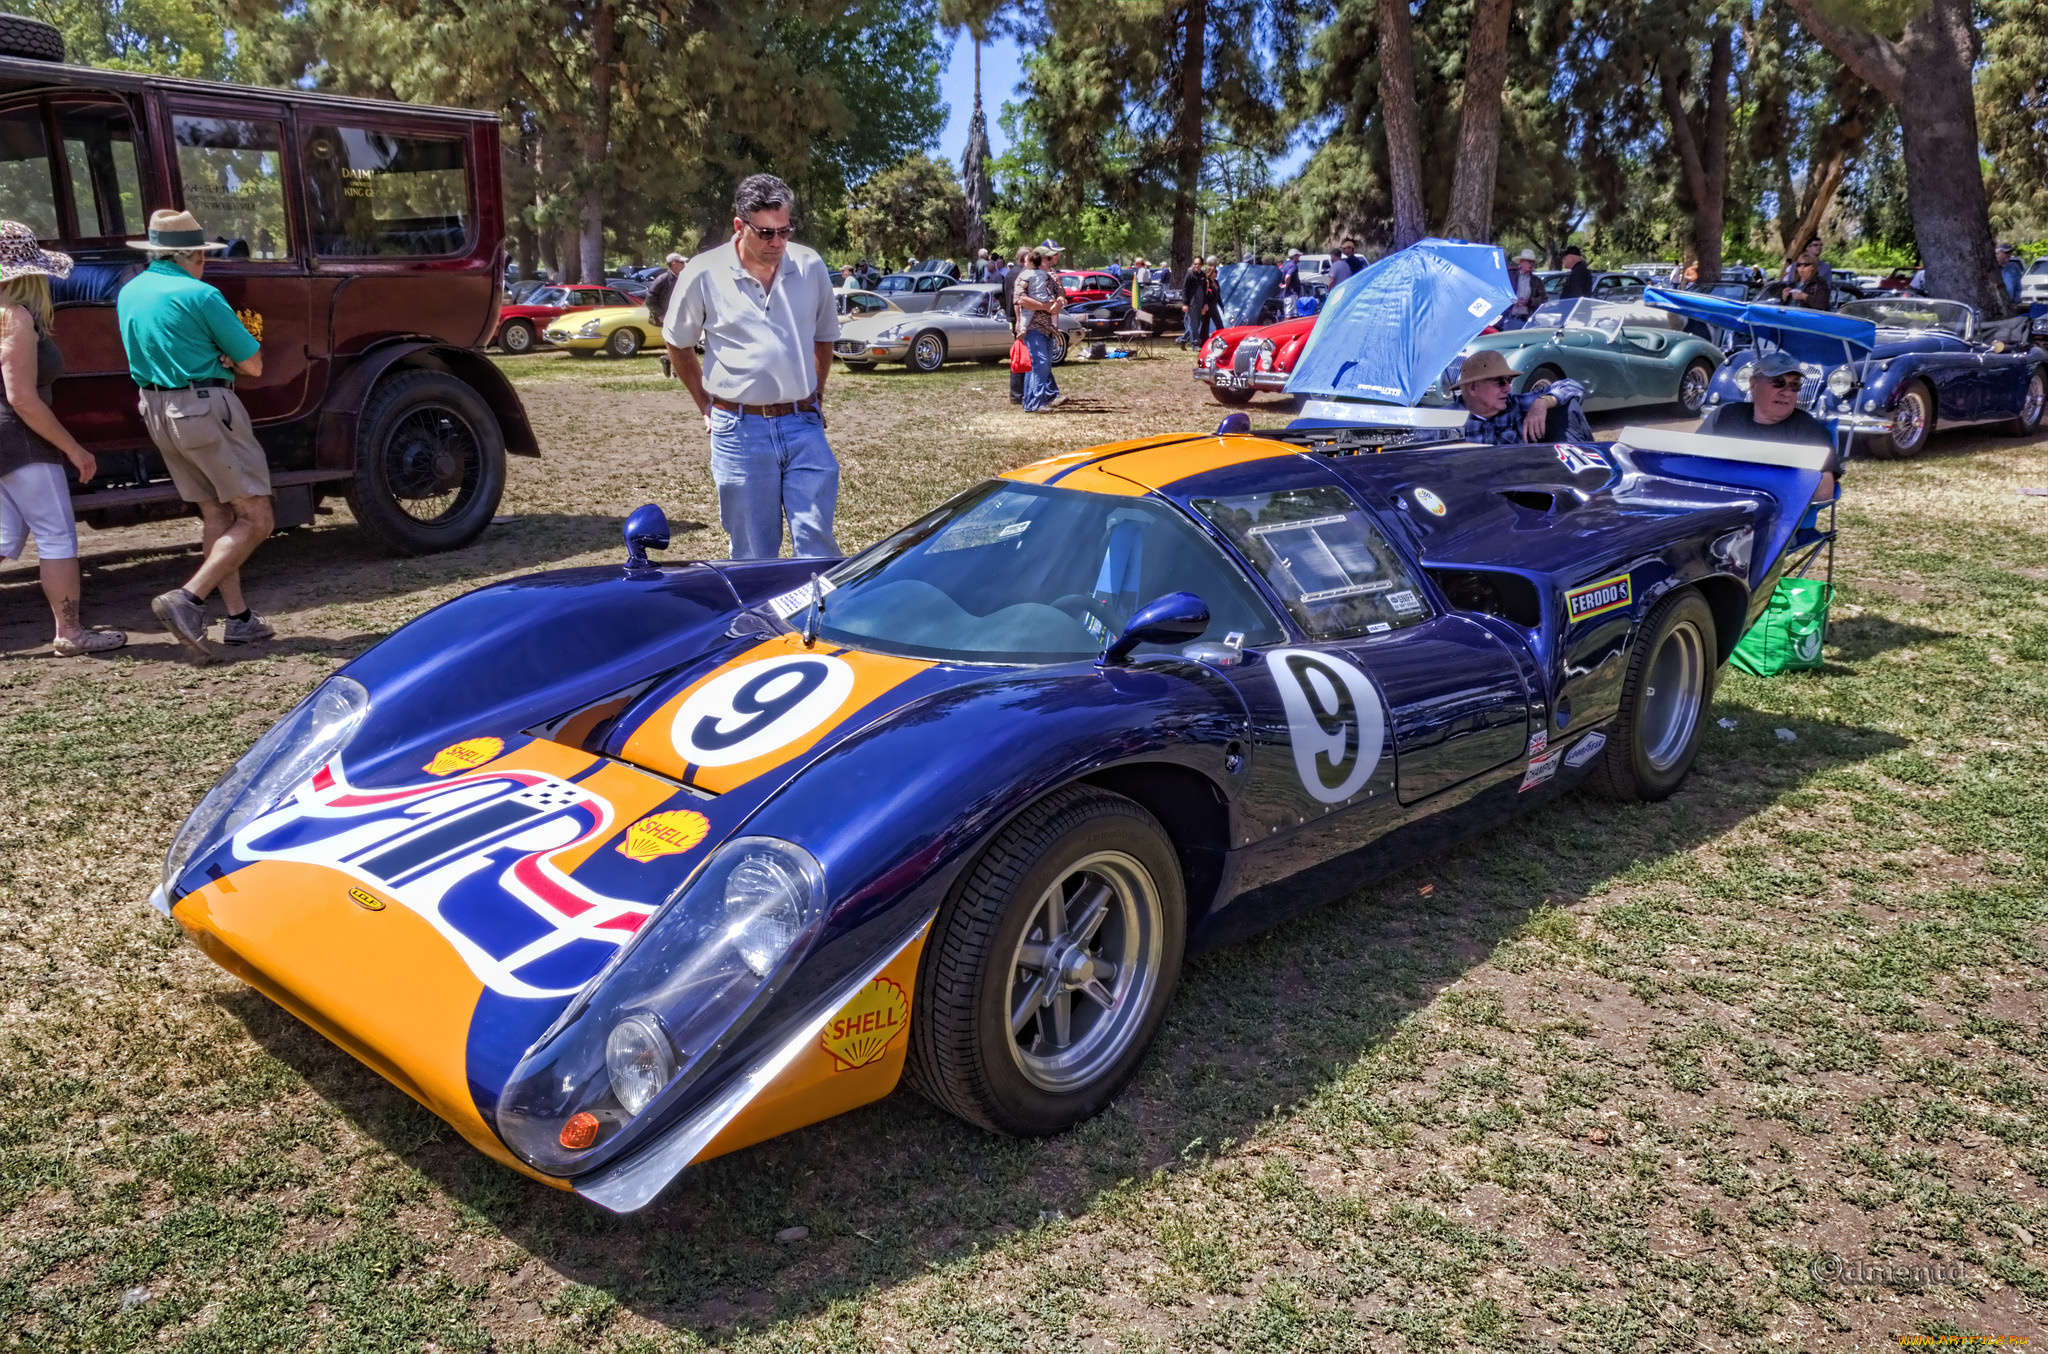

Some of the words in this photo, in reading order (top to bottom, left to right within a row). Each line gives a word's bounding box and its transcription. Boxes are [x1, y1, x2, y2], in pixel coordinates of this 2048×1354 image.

[1570, 585, 1618, 614] FERODO
[691, 660, 829, 751] 9
[1284, 654, 1360, 790] 9
[446, 746, 485, 764] SHELL
[639, 821, 690, 848] SHELL
[832, 1006, 898, 1041] SHELL
